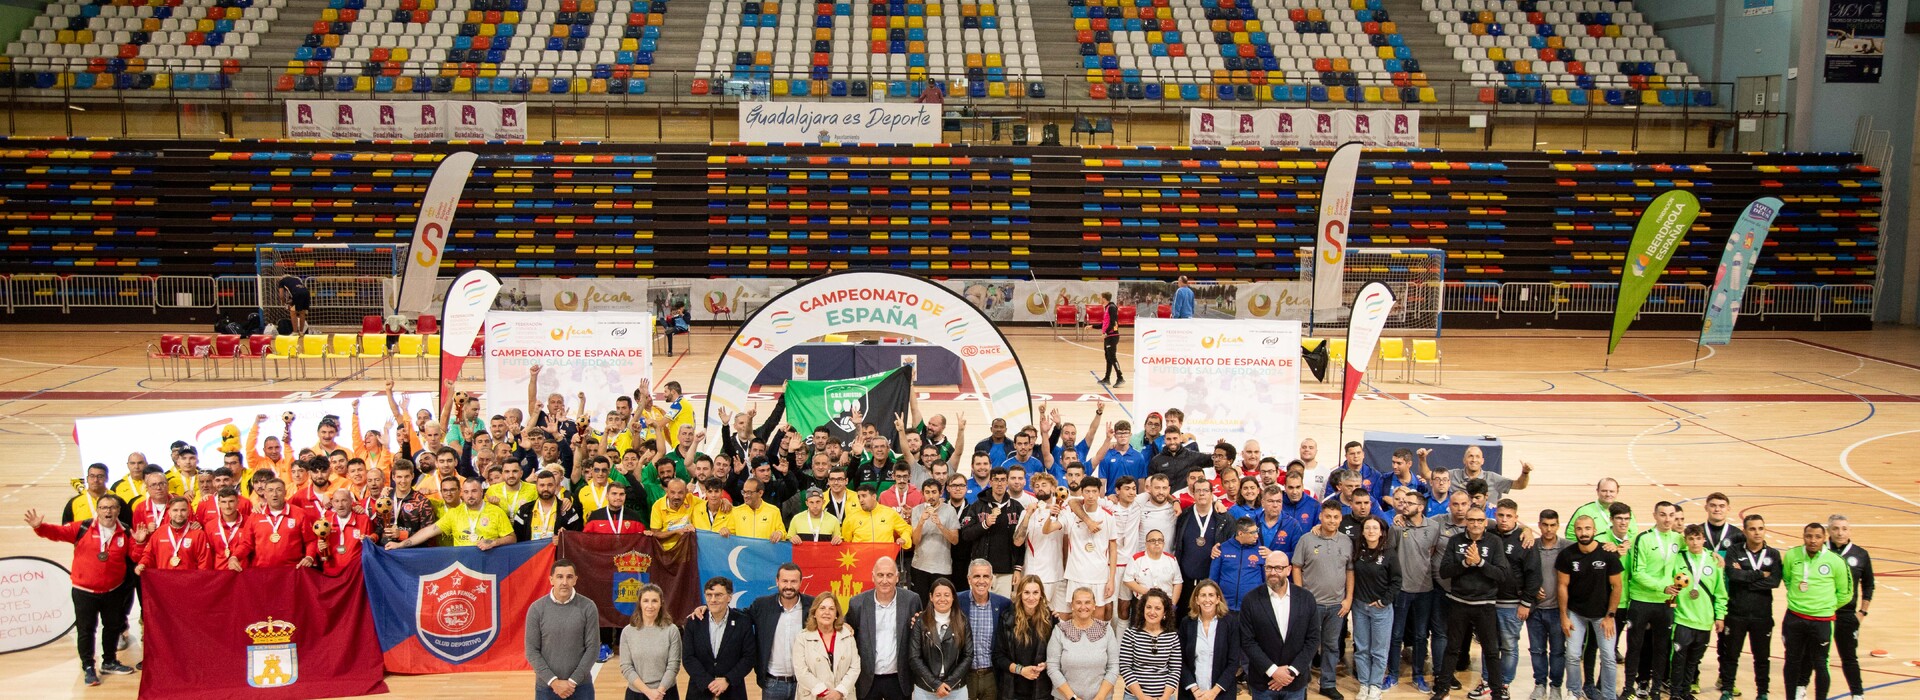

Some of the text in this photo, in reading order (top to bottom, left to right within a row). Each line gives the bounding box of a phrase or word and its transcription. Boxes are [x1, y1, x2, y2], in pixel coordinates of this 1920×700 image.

[746, 104, 931, 133] Guadalajara es Deporte
[1753, 208, 1769, 219] DEUS
[1754, 203, 1772, 214] AQUA
[1645, 203, 1686, 257] IBERDROLA
[1655, 224, 1686, 261] ESPAÑA
[583, 285, 635, 312] fecam
[799, 288, 945, 317] CAMPEONATO DE
[826, 305, 919, 330] ESPAÑA
[566, 325, 593, 341] fecam
[491, 347, 643, 358] CAMPEONATO DE ESPAÑA DE
[546, 359, 572, 367] SALA
[609, 359, 634, 367] 2024
[1142, 356, 1293, 367] CAMPEONATO DE ESPAÑA DE
[1195, 367, 1222, 375] SALA
[437, 590, 477, 602] ABDERA FENICIA
[434, 637, 481, 647] CLUB DEPORTIVO
